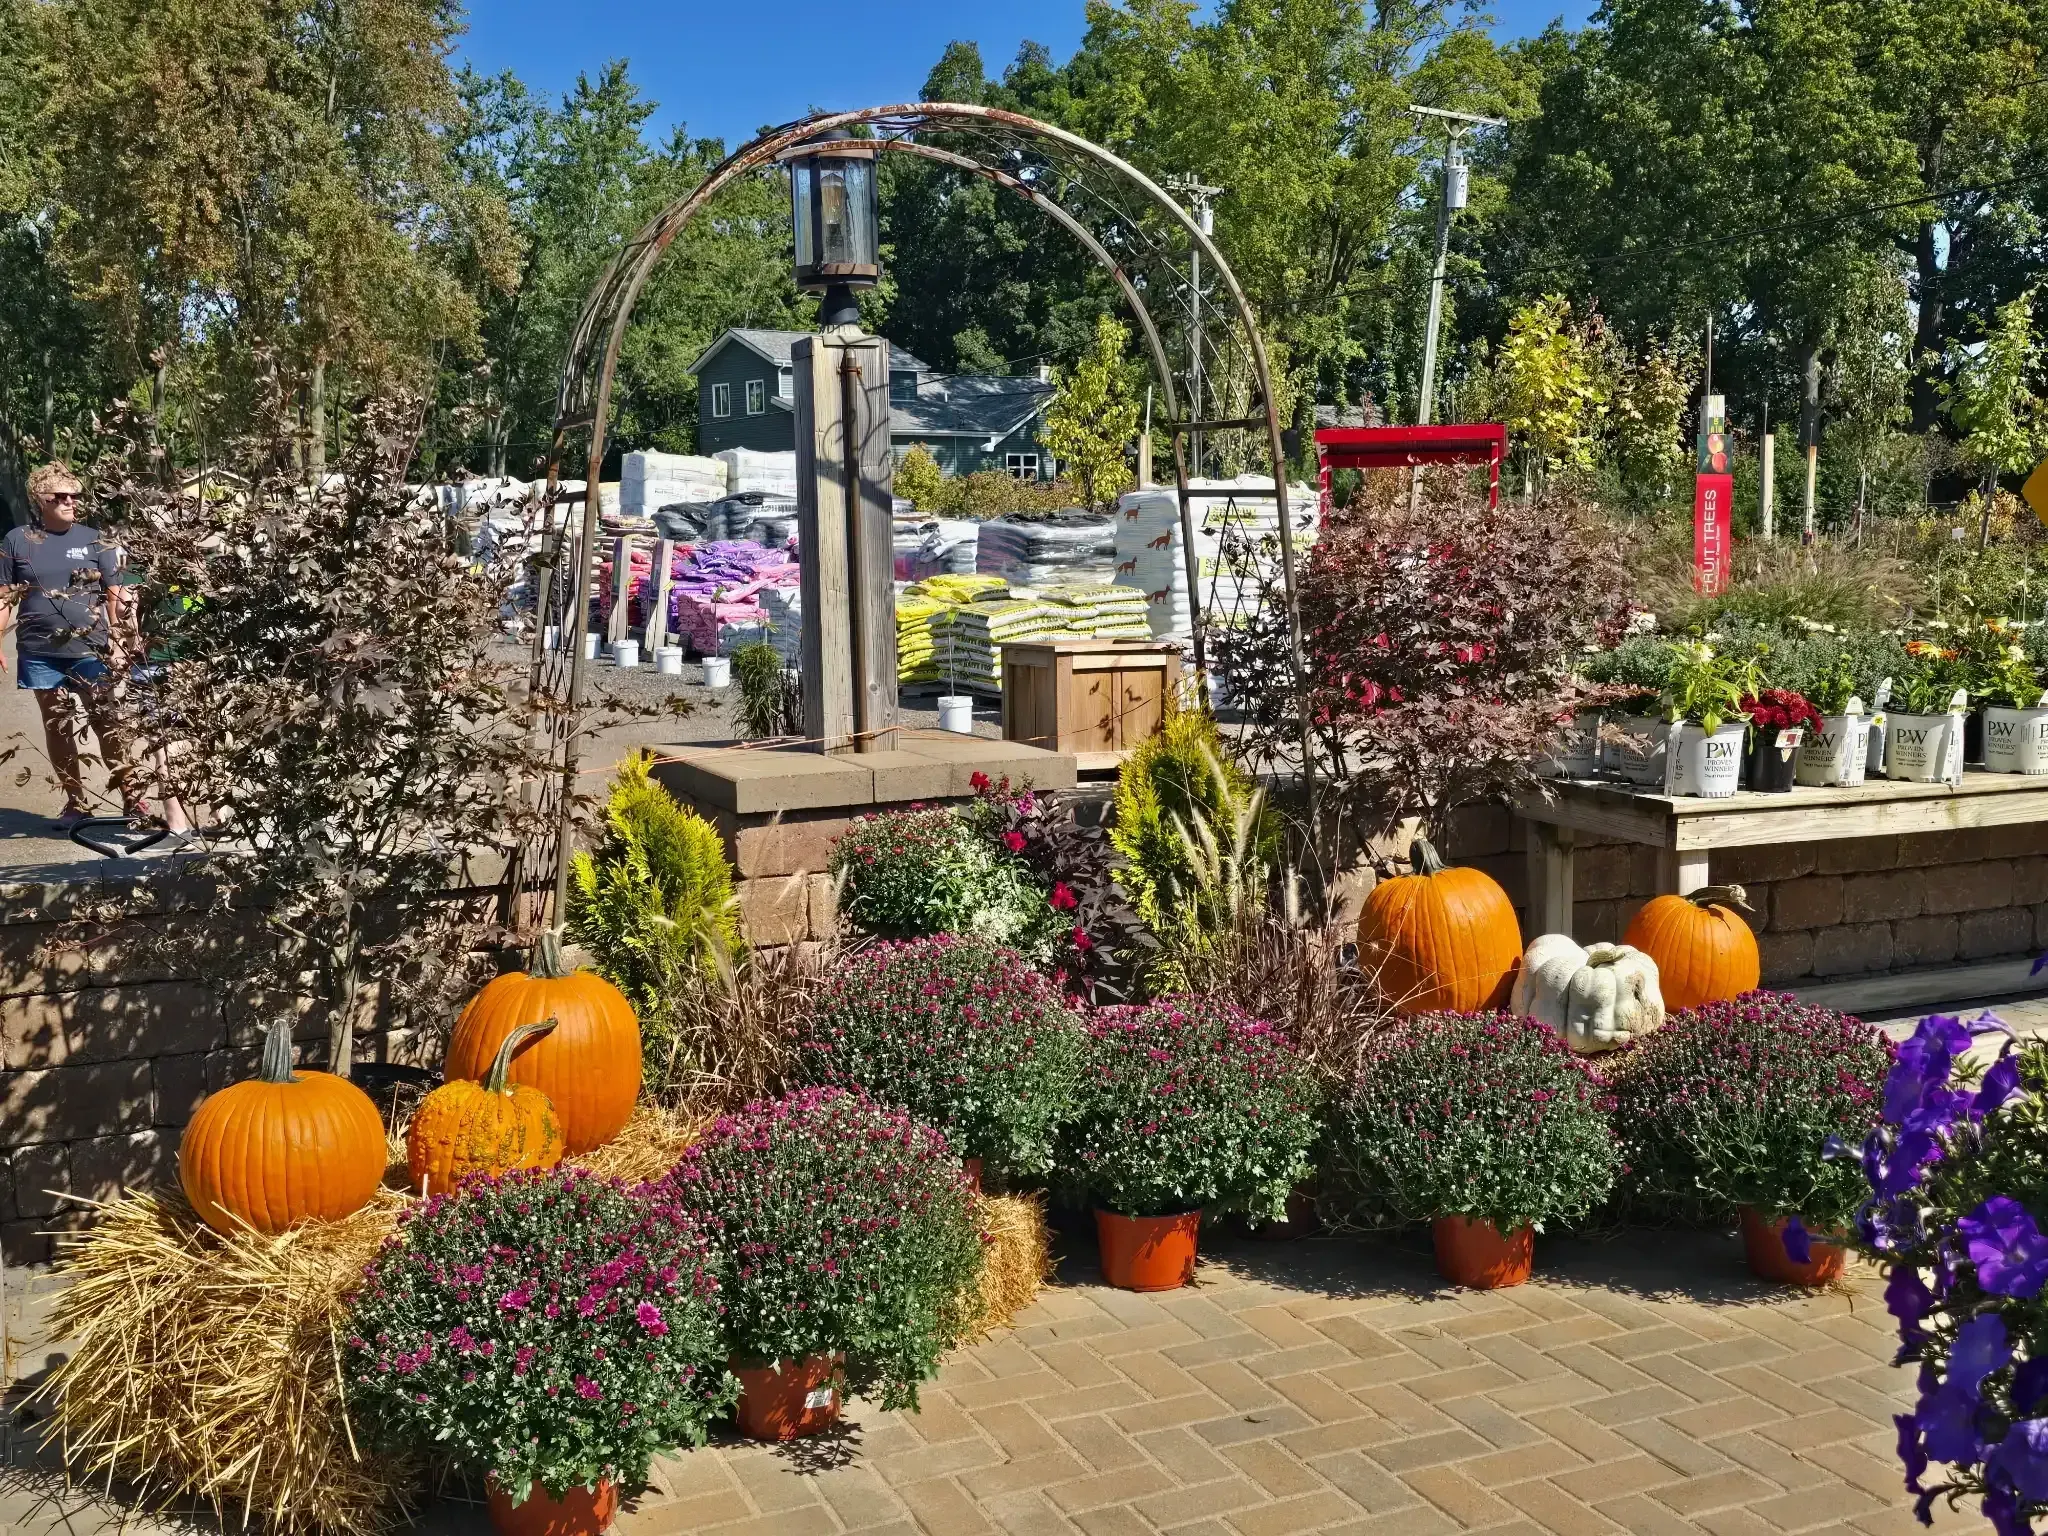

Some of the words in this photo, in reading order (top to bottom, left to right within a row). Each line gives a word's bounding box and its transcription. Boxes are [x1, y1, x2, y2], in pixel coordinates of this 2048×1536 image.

[1704, 489, 1717, 543] TREES
[1703, 549, 1715, 593] FRUIT
[1705, 742, 1737, 759] PW
[1896, 728, 1928, 744] PW
